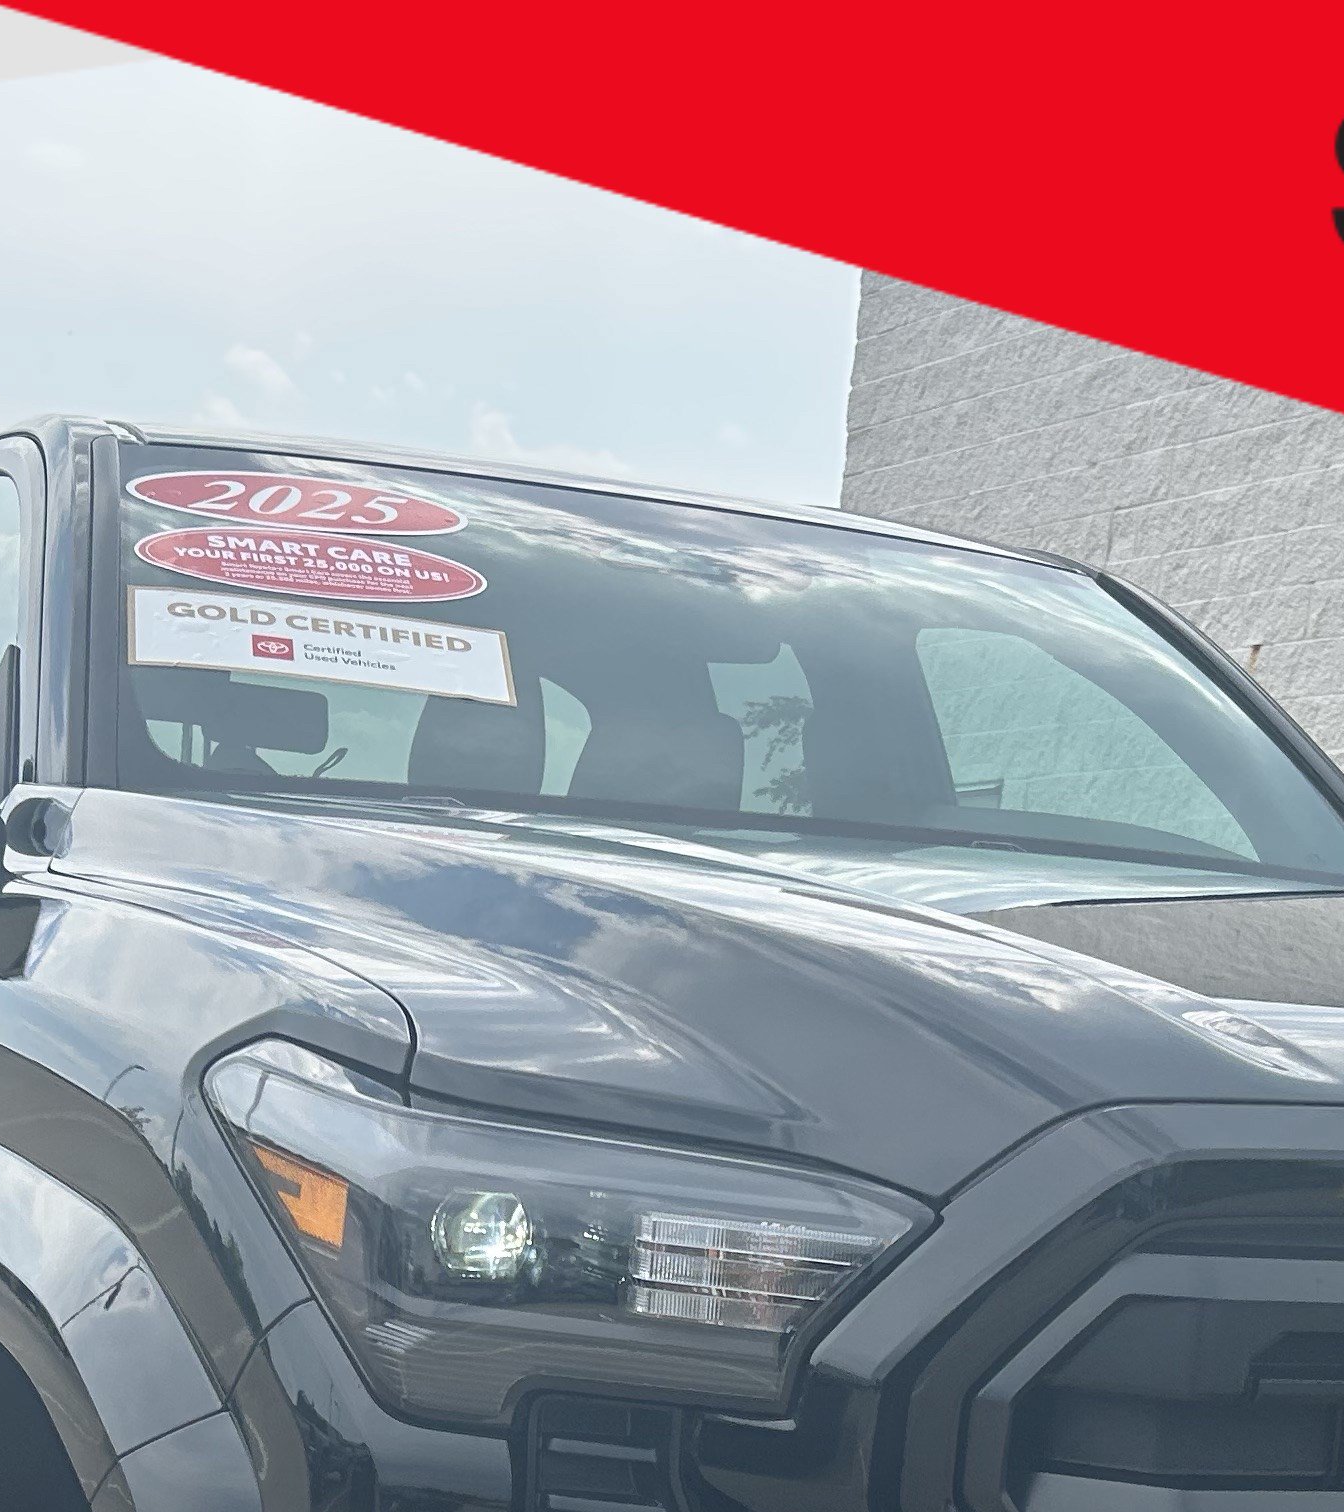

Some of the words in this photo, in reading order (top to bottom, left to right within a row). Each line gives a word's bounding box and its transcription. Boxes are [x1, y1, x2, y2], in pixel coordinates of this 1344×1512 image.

[187, 480, 409, 524] 2025
[173, 546, 237, 561] YOUR
[240, 551, 299, 566] FIRST
[377, 565, 411, 578] ON
[415, 569, 451, 583] US!
[207, 535, 320, 557] SMART
[327, 546, 412, 568] CARE
[166, 601, 277, 627] GOLD
[285, 614, 473, 653] CERTIFIED
[303, 643, 362, 657] Certified
[304, 652, 338, 664] Used
[341, 656, 397, 671] Vehicles
